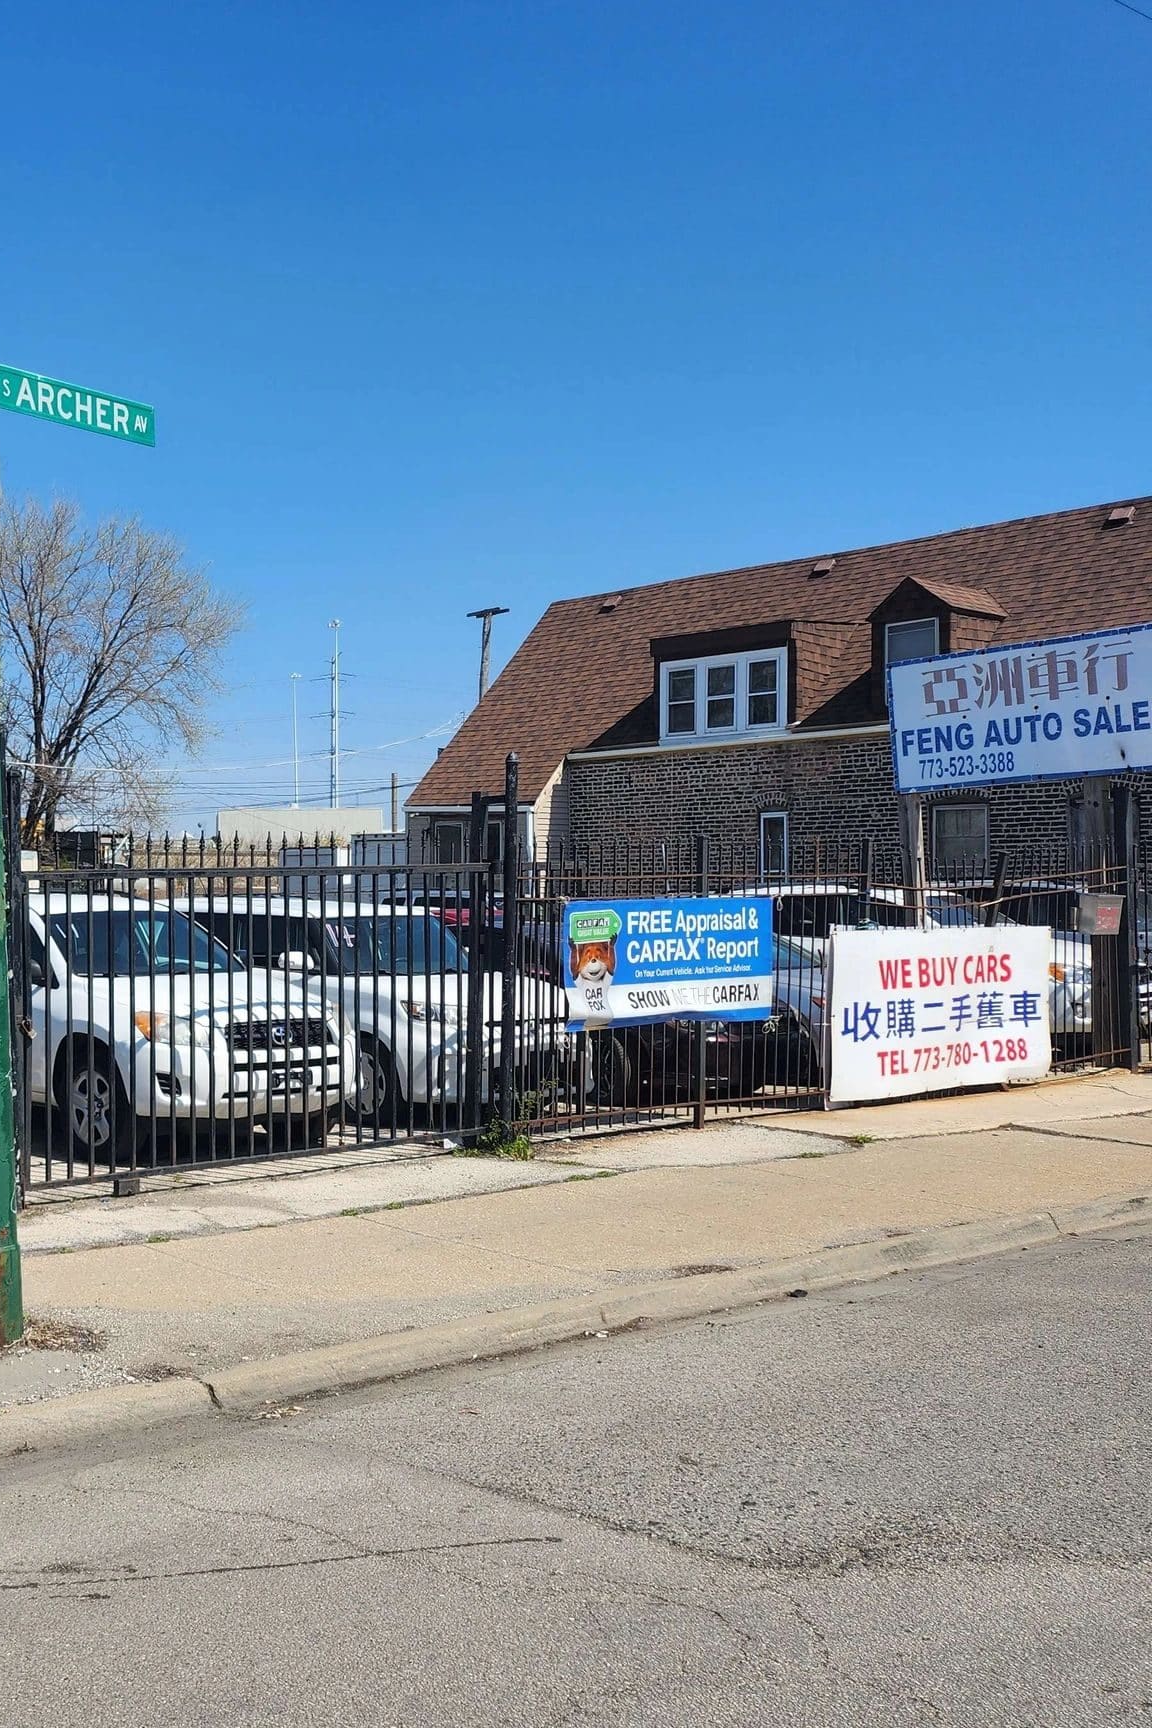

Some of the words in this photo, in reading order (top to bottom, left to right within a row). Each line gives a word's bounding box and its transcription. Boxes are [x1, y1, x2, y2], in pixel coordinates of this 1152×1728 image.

[2, 378, 11, 397] S
[15, 377, 130, 434] ARCHER
[133, 416, 148, 432] AV
[921, 639, 1135, 718] 亞洲車行
[901, 722, 974, 757] FENG
[983, 711, 1063, 748] AUTO
[1073, 700, 1151, 738] SALE
[918, 751, 1015, 780] 773-523-3388
[627, 910, 673, 934] FREE
[674, 906, 747, 937] Appraisal
[748, 907, 759, 930] &
[707, 936, 759, 964] Report
[878, 958, 912, 990] WE
[919, 956, 957, 988] BUY
[963, 954, 1012, 985] CARS
[585, 987, 603, 1000] CAR
[588, 1000, 606, 1011] FOX
[628, 989, 671, 1009] SHOW
[689, 986, 713, 1005] THE
[712, 983, 760, 1004] CARFAX
[841, 990, 1042, 1043] 收購二手舊車
[877, 1050, 909, 1077] TEL
[913, 1037, 1029, 1073] 773-780-1288
